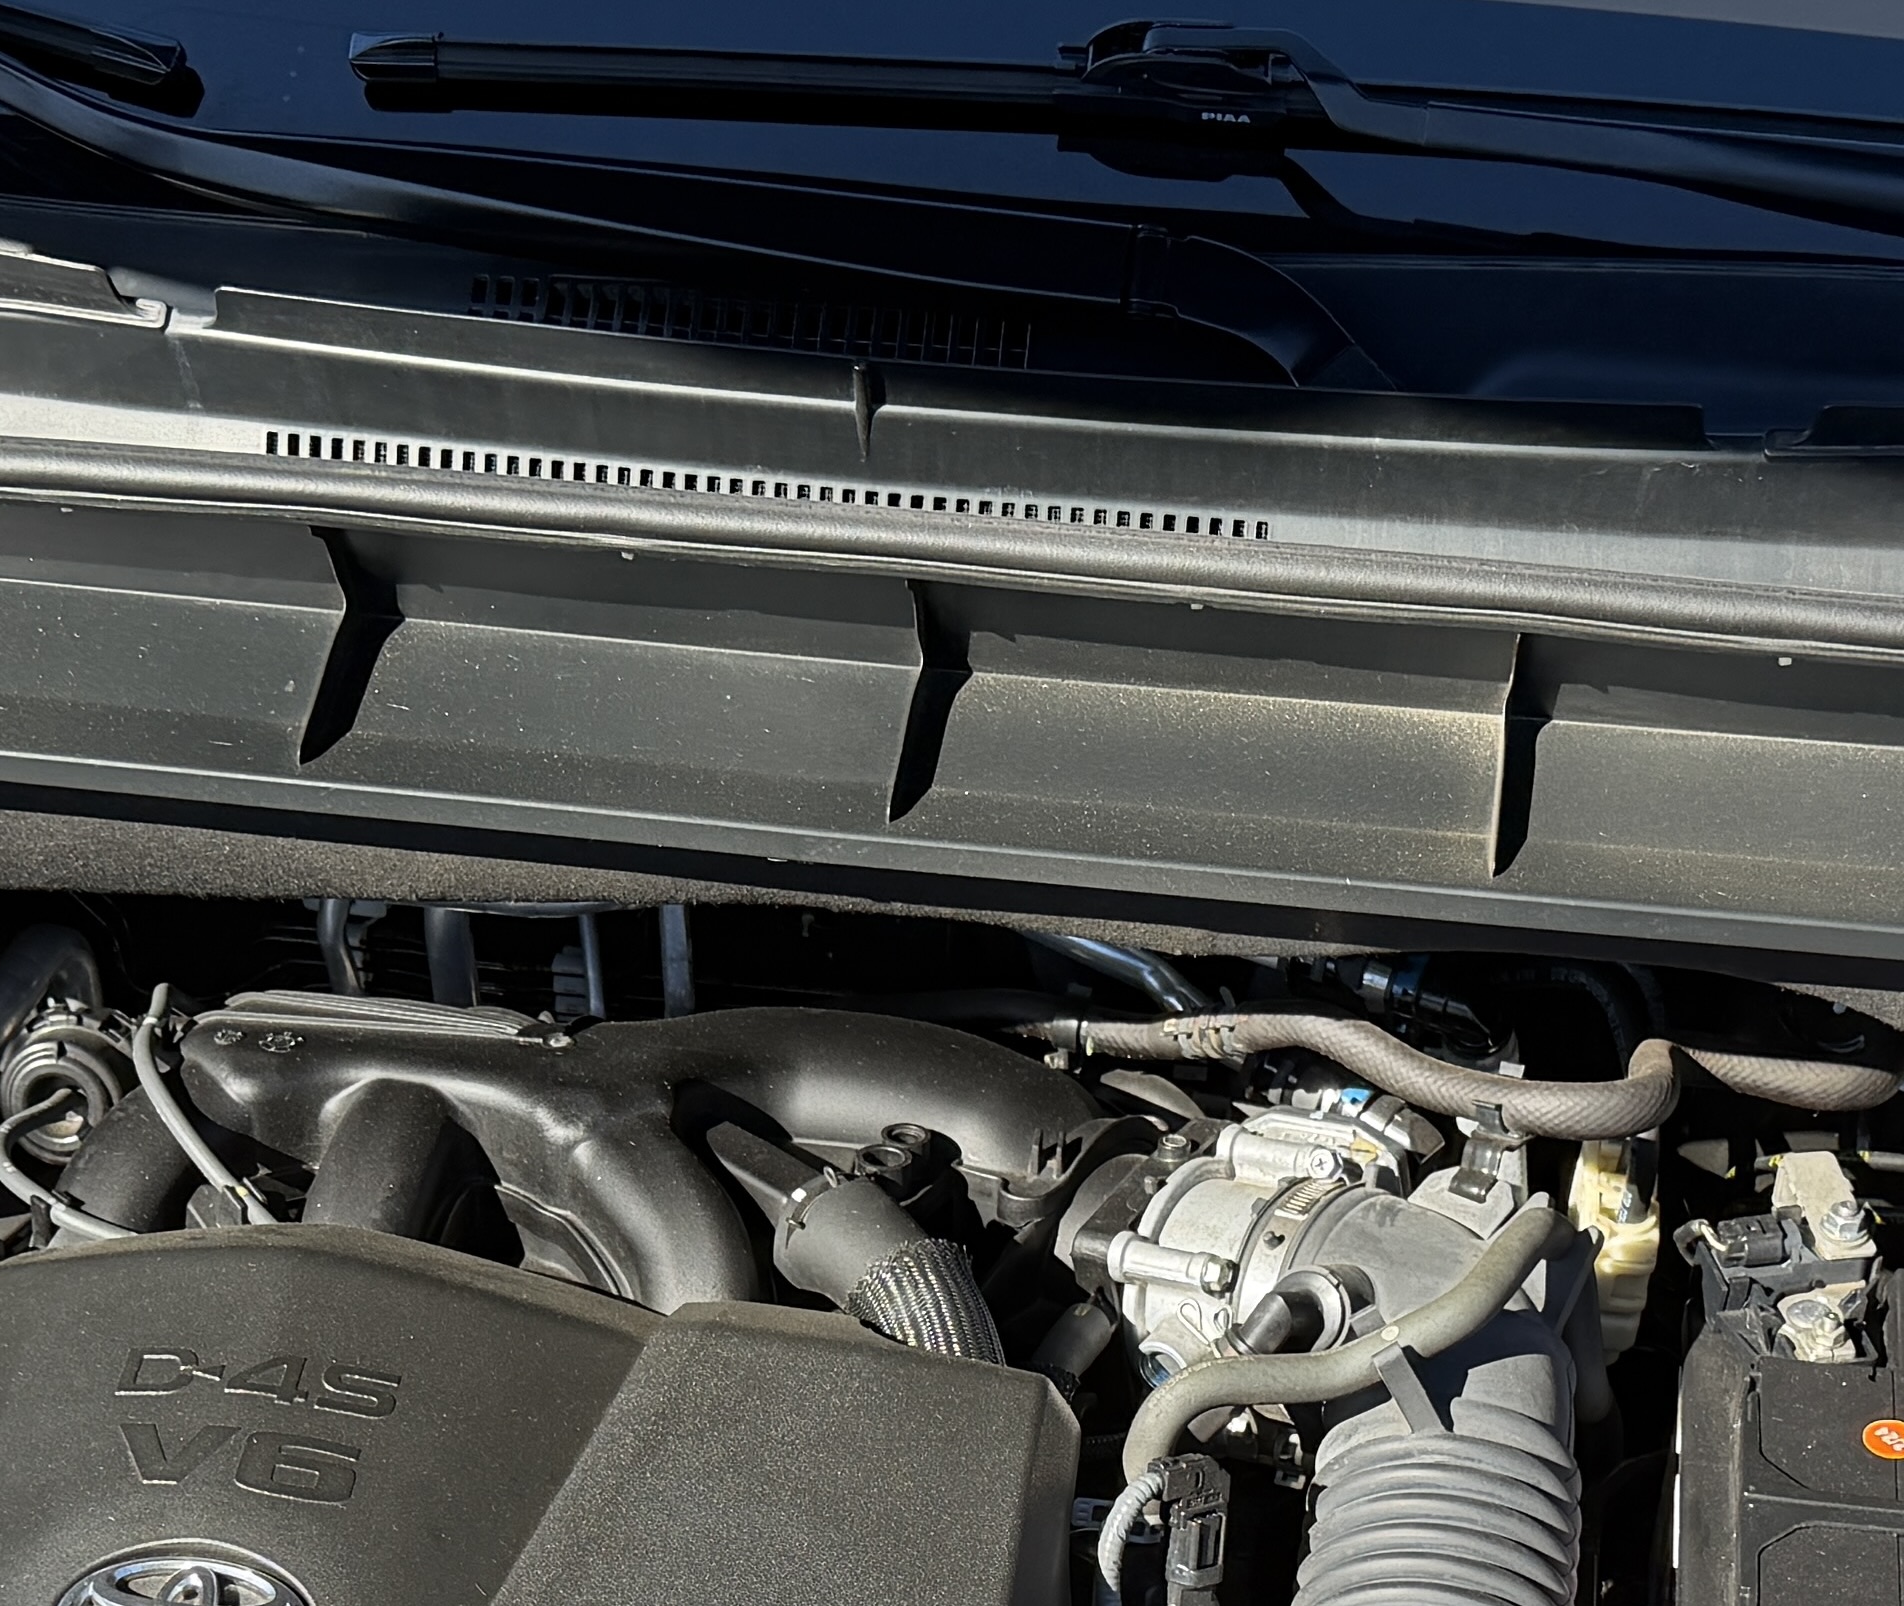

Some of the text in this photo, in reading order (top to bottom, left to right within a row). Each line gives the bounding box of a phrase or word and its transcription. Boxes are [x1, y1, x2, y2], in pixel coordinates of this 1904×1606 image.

[1200, 111, 1251, 124] PIAA
[114, 1346, 403, 1420] D-4S
[118, 1422, 362, 1506] V6
